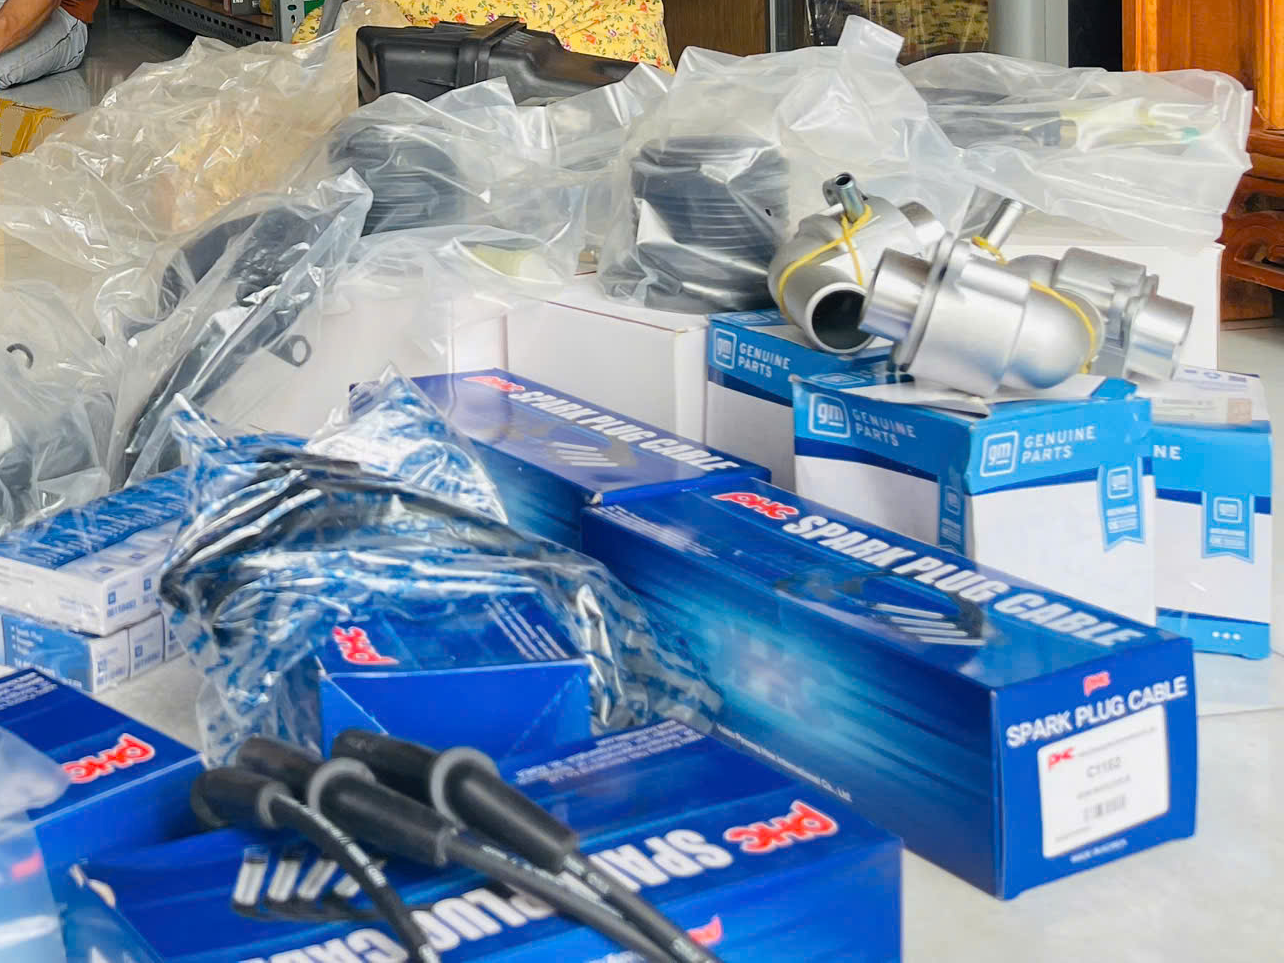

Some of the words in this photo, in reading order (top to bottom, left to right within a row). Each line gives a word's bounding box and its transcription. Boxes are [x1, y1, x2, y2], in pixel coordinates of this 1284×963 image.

[737, 353, 773, 379] PARTS
[739, 342, 791, 372] GENUINE
[508, 390, 593, 426] SPARK
[583, 413, 659, 443] PLUG
[852, 408, 917, 440] GENUINE
[854, 421, 899, 447] PARTS
[1024, 425, 1096, 451] GENUINE
[1021, 444, 1072, 464] PARTS
[784, 514, 912, 570] SPARK
[892, 553, 1011, 603] PLUG
[995, 589, 1147, 647] CABLE
[1006, 713, 1072, 748] SPARK
[1075, 693, 1125, 728] PLUG
[1128, 676, 1187, 710] CABLE
